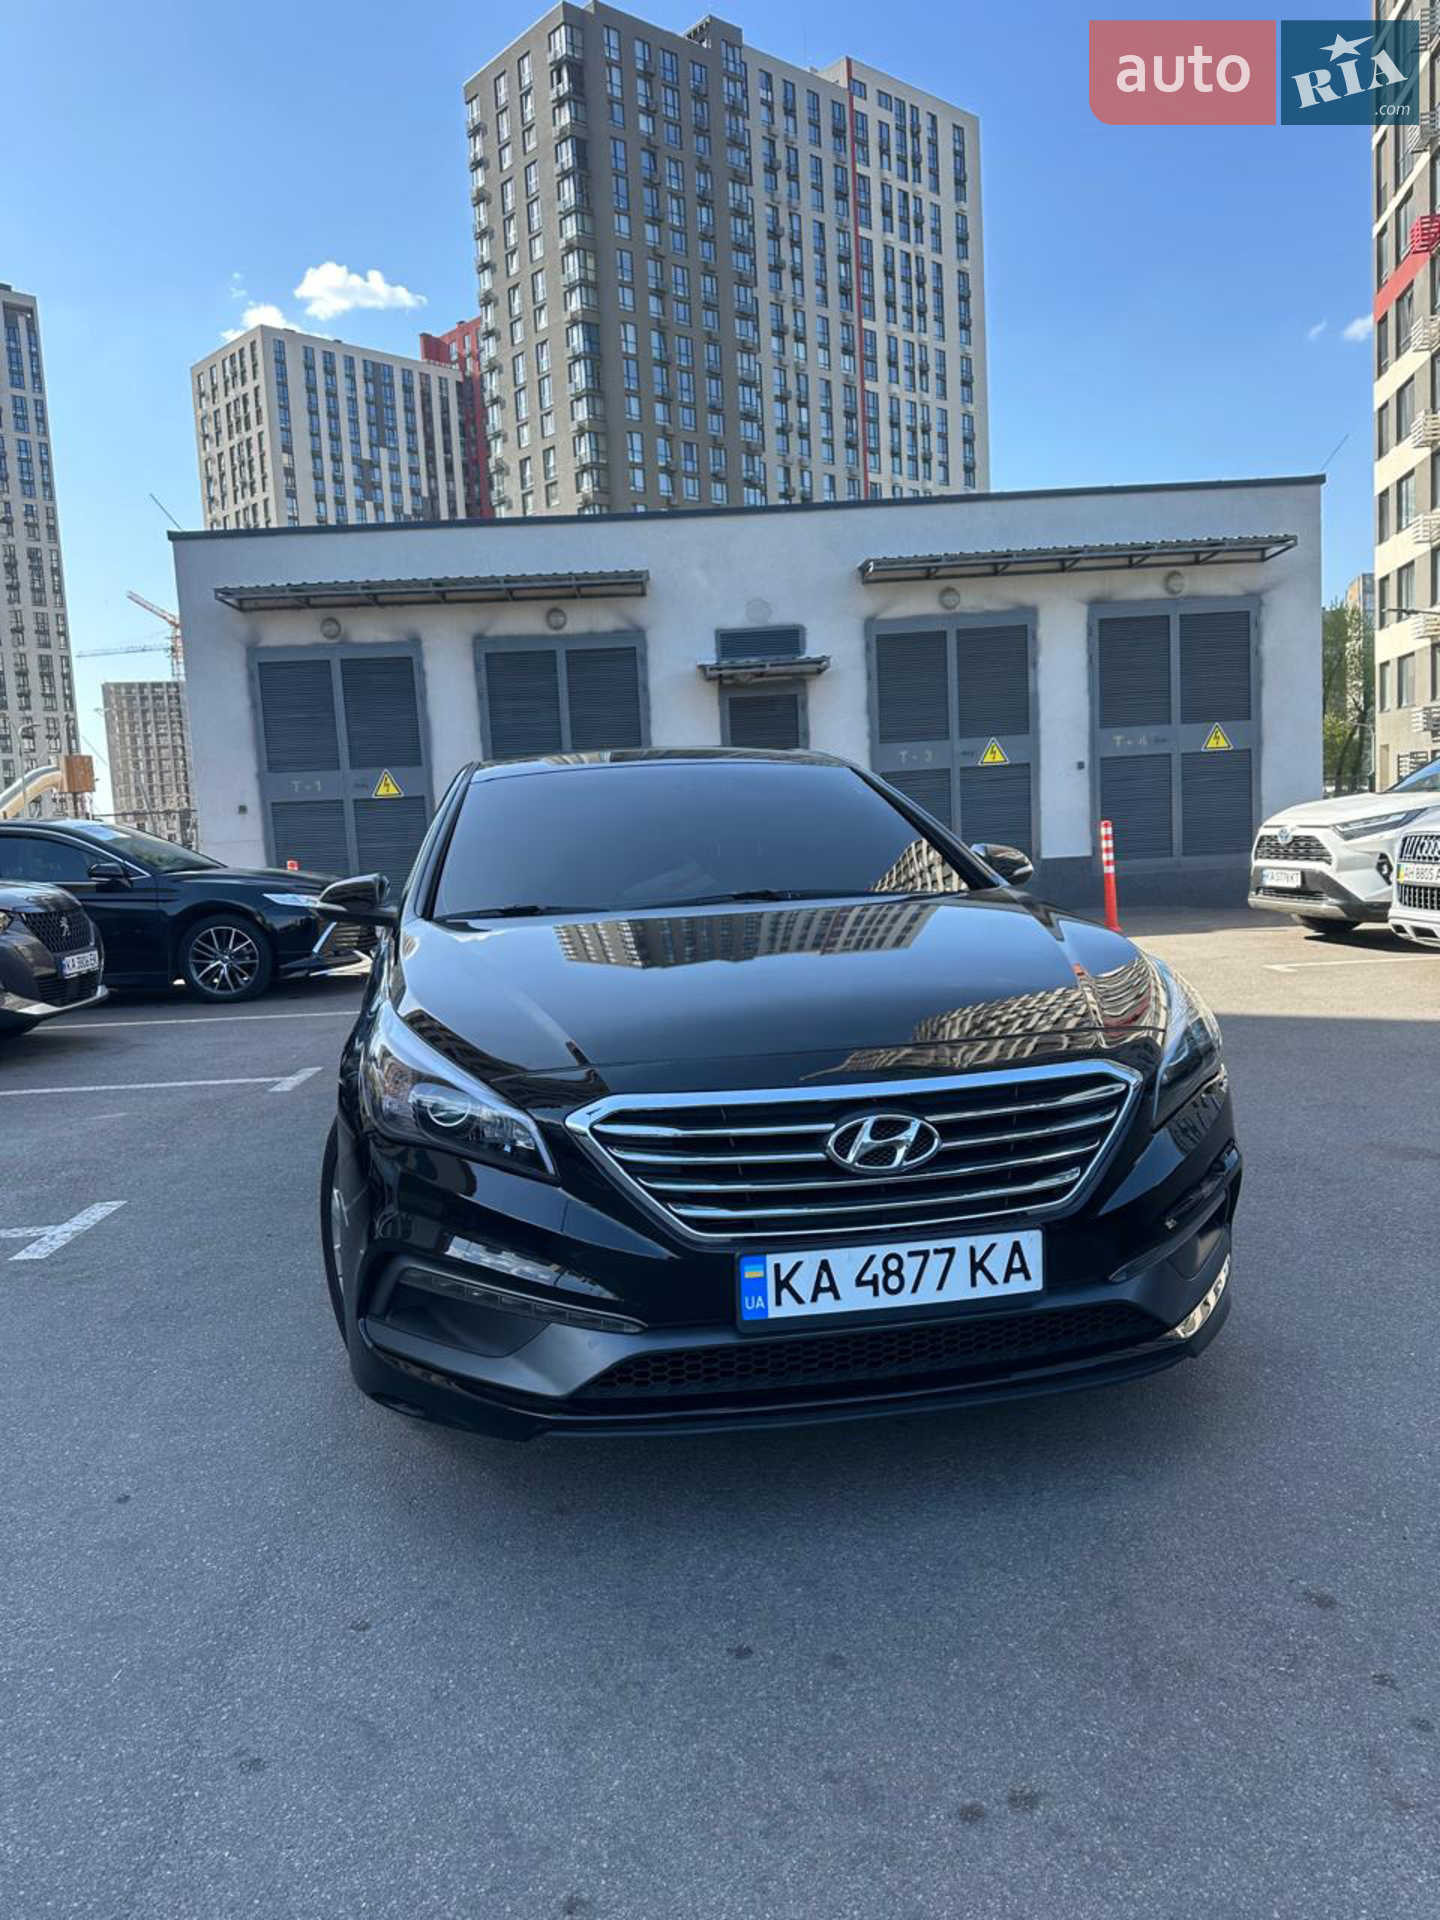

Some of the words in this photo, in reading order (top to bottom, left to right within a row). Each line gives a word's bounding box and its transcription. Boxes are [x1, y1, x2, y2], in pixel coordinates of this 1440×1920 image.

[773, 1258, 842, 1307] KA
[855, 1247, 957, 1297] 4877
[969, 1240, 1032, 1288] KA
[745, 1295, 765, 1310] UA
